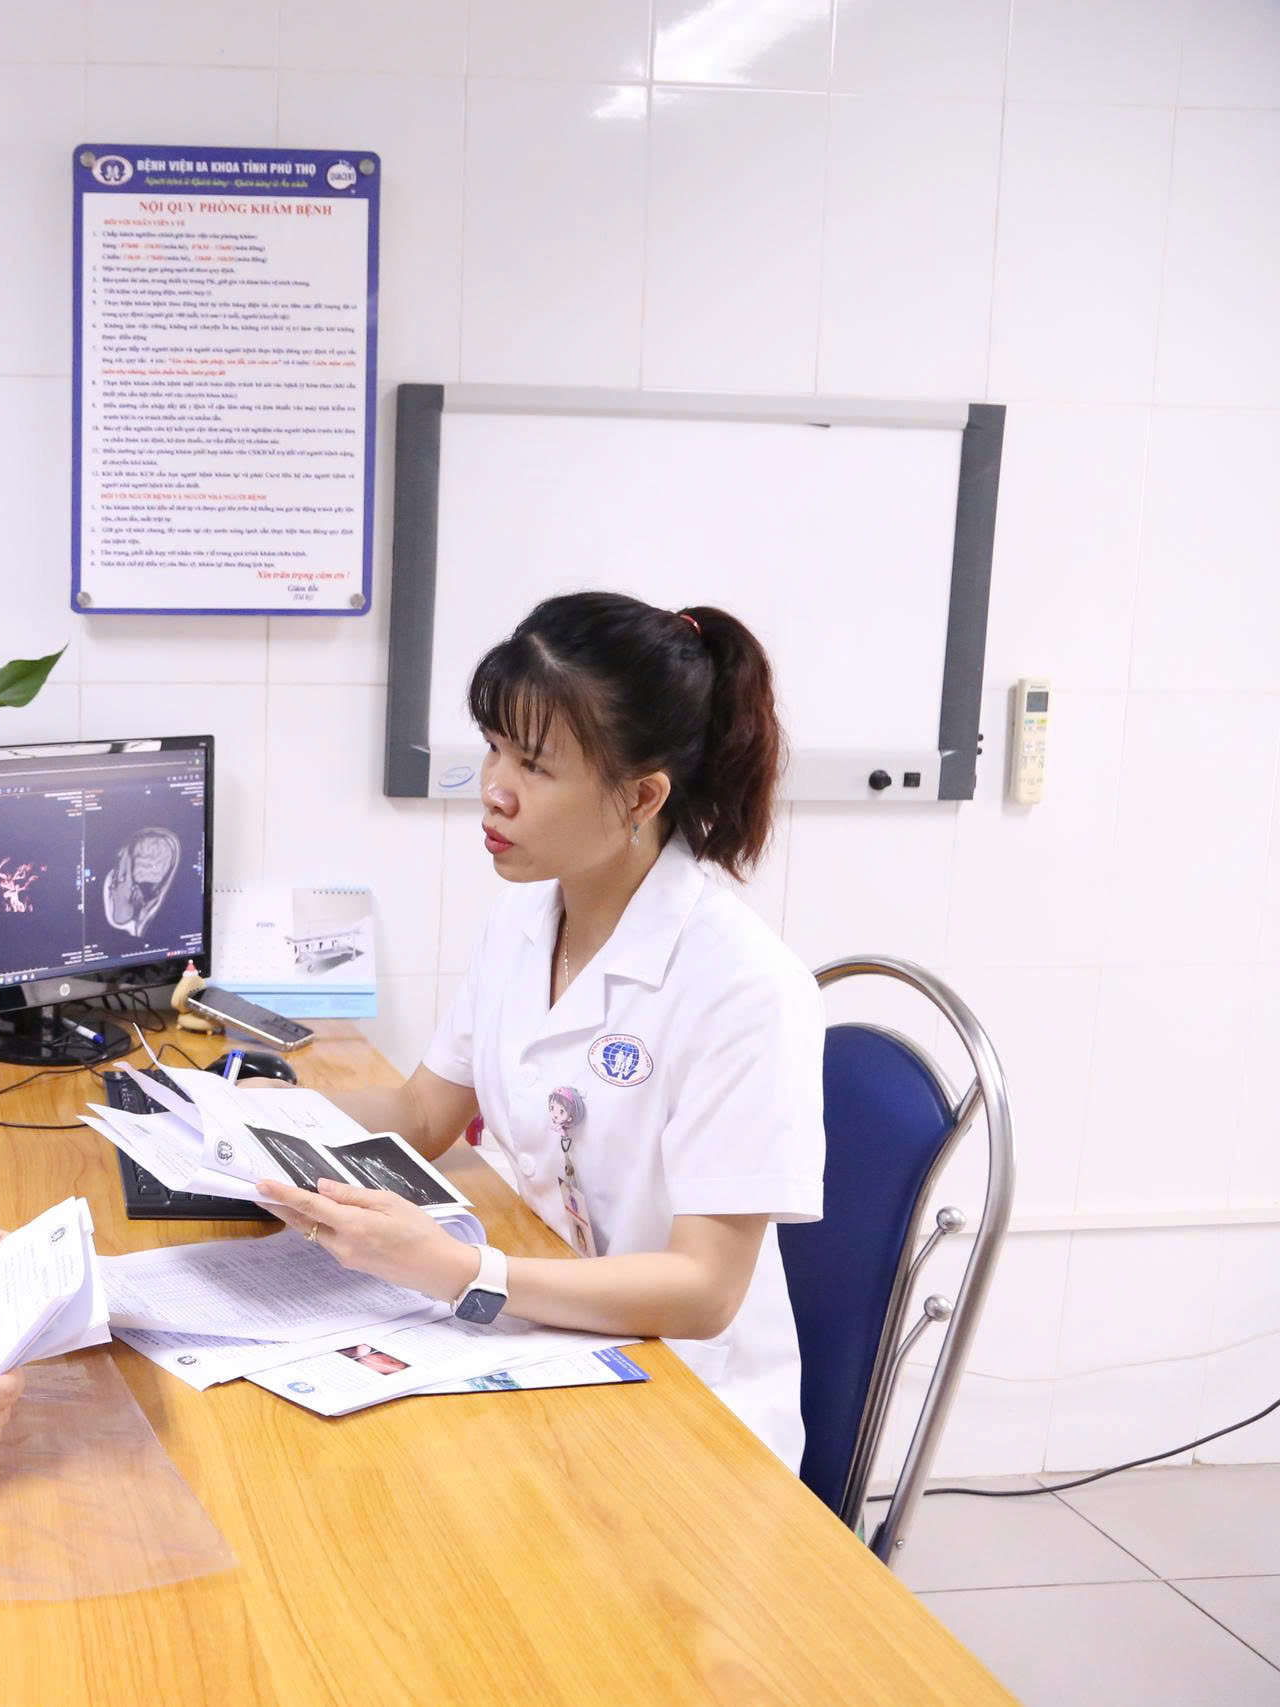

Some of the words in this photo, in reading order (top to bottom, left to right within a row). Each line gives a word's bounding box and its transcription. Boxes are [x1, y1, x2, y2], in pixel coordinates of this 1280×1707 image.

[136, 158, 167, 174] BỆNH
[169, 158, 193, 175] VIỆN
[214, 162, 240, 174] KHOA
[296, 163, 316, 177] THỌ
[140, 200, 164, 216] NỘI
[167, 201, 194, 214] QUY
[200, 200, 248, 214] PHÒNG
[251, 201, 292, 216] KHÁM
[296, 202, 333, 218] BỆNH
